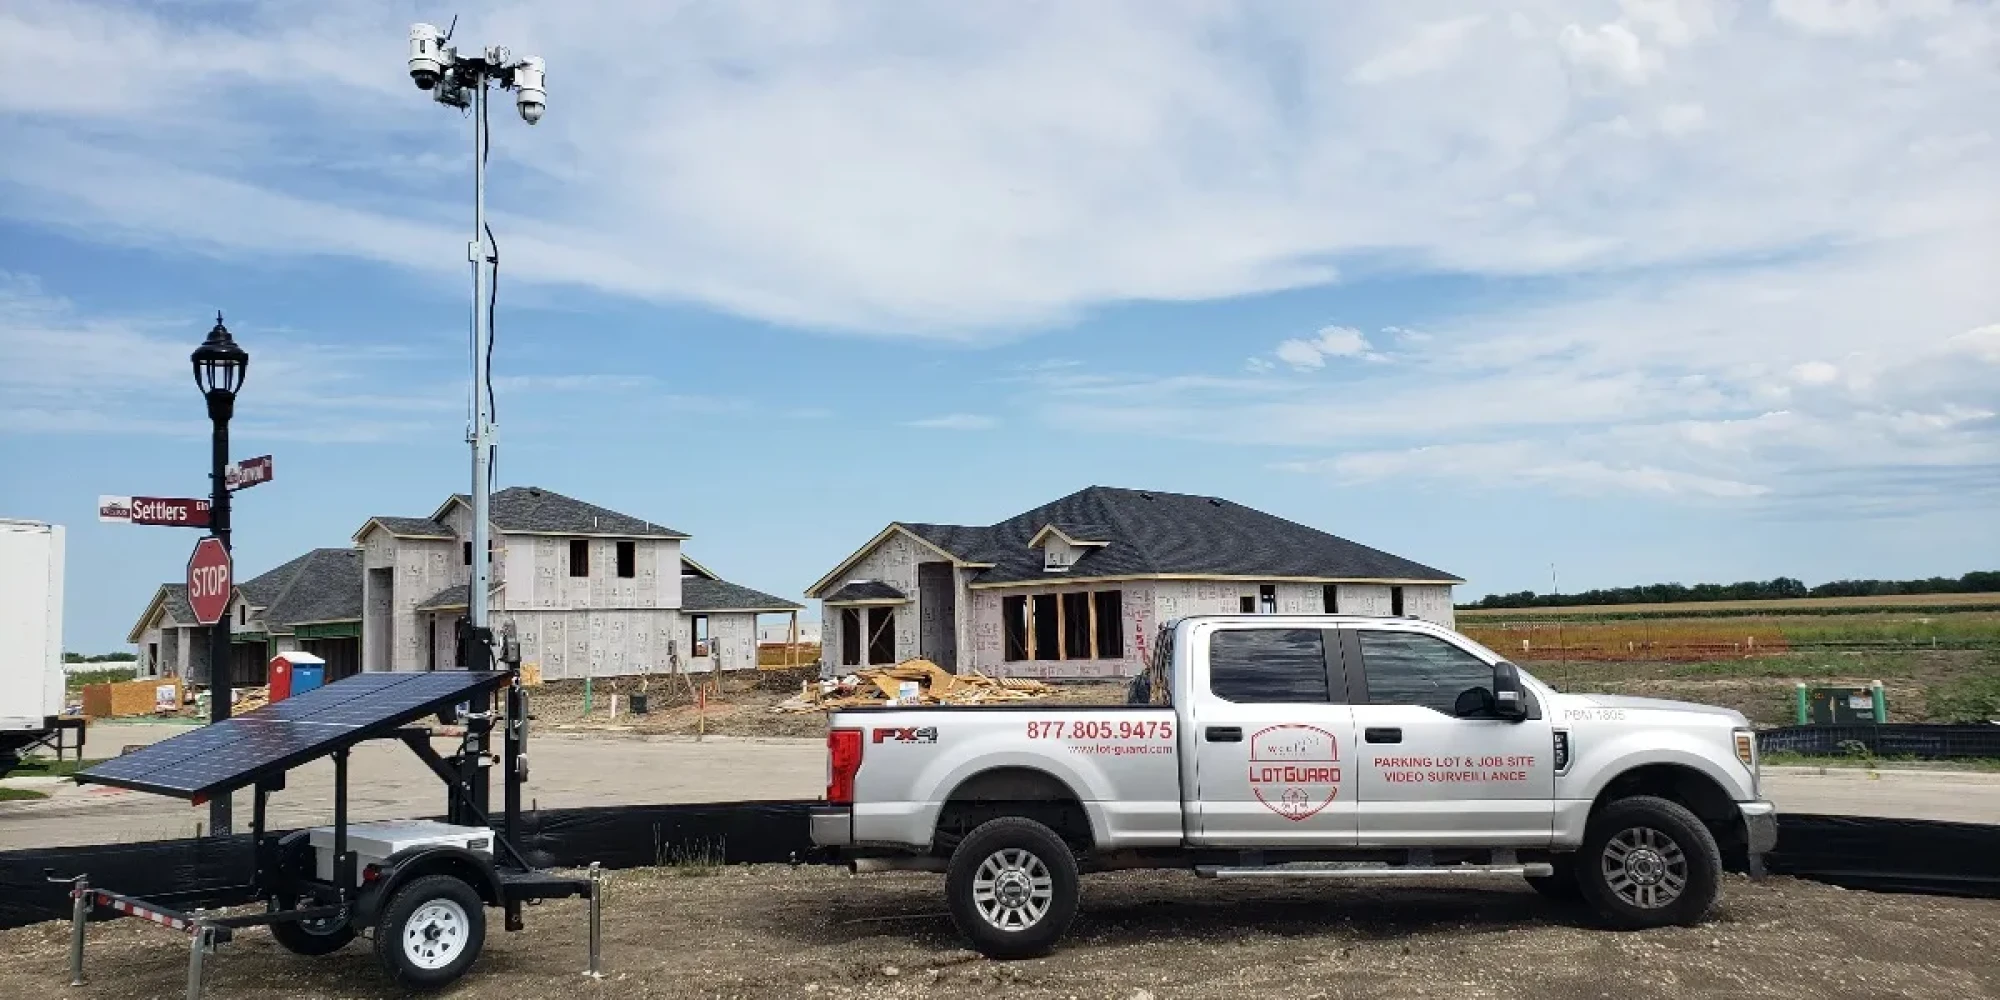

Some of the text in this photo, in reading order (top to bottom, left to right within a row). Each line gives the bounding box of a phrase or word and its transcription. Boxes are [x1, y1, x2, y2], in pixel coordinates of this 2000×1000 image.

[133, 500, 188, 521] Settlers
[192, 565, 227, 598] STOP
[1597, 709, 1625, 720] 1805
[873, 727, 938, 743] FX4
[1027, 721, 1173, 739] 877.805.9475
[1067, 744, 1173, 756] www.lot-guard.com
[1374, 756, 1536, 768] PARKING LOT & JOB SITE
[1384, 771, 1526, 783] VIDEO SURVEILLANCE
